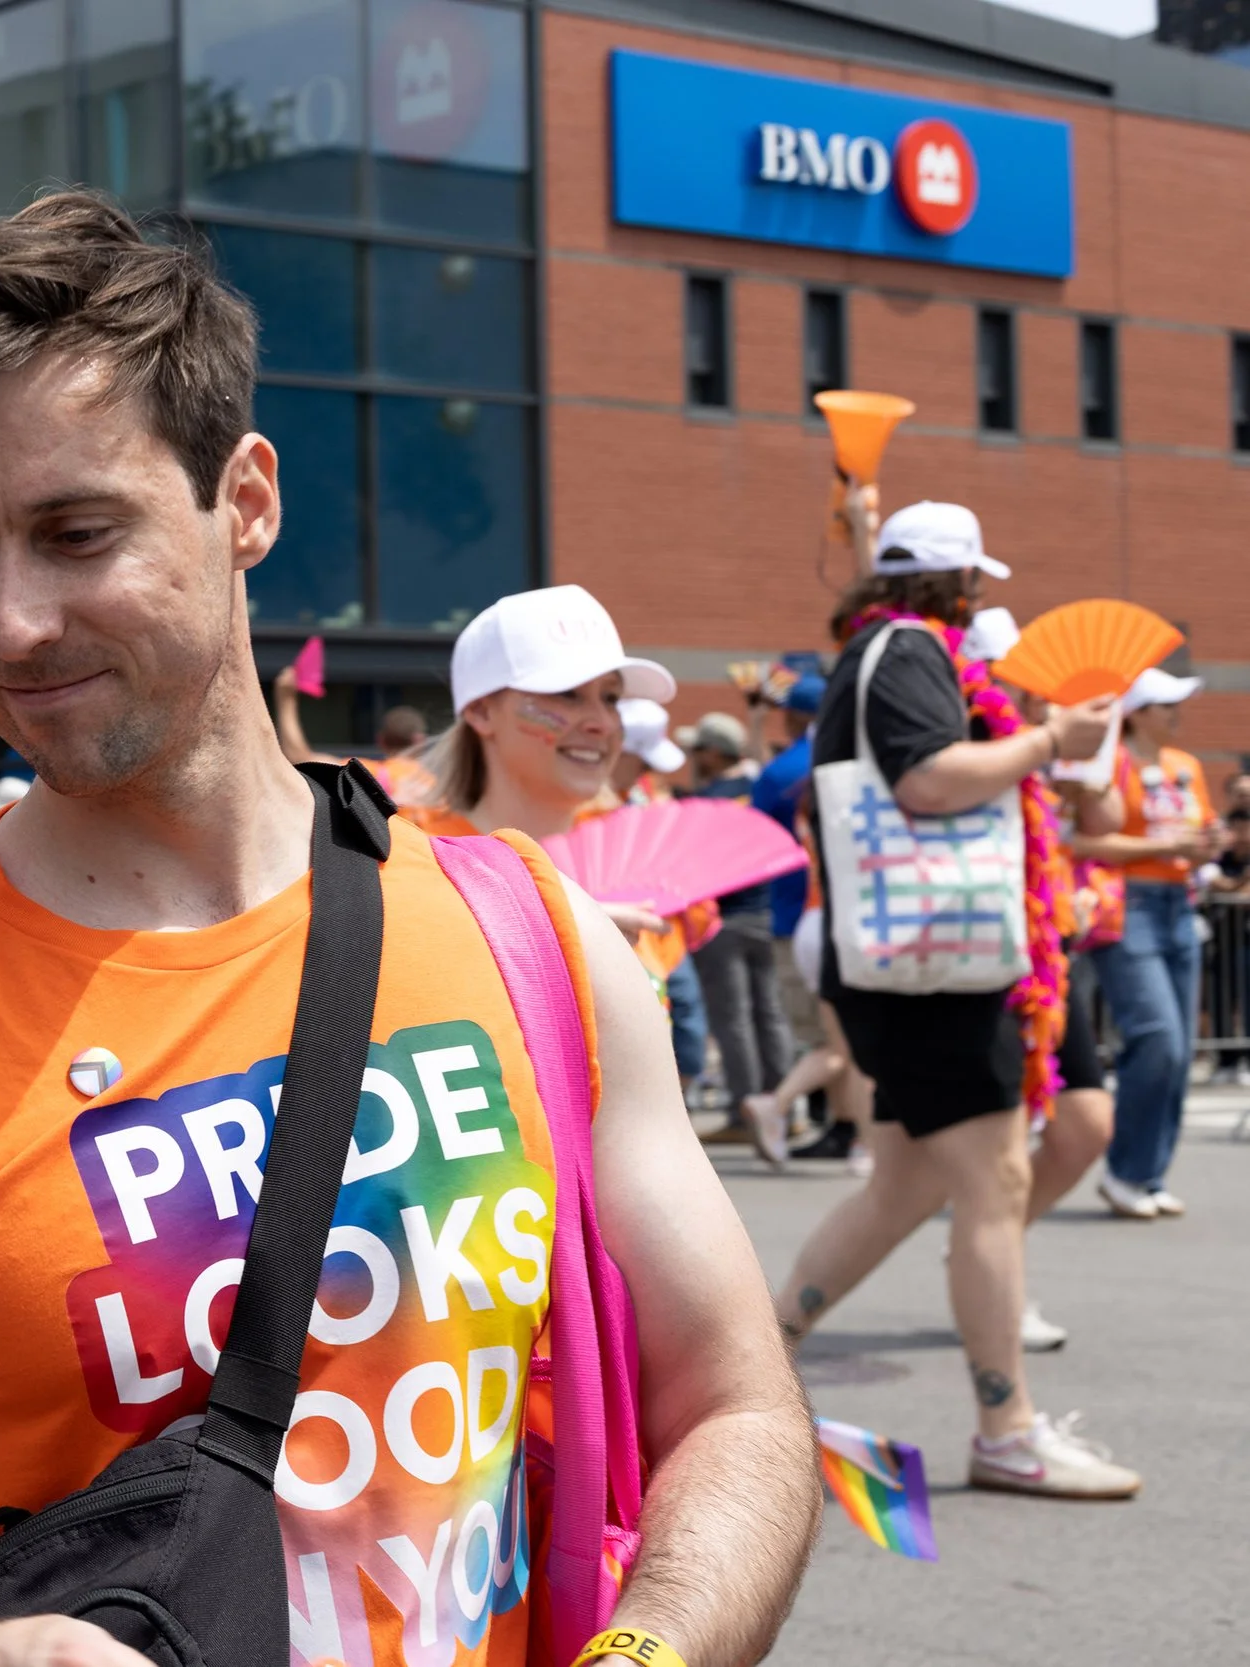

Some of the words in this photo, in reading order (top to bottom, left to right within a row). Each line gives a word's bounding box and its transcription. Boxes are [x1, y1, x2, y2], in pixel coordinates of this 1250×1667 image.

[759, 121, 892, 196] BMO
[93, 1044, 505, 1246] PRDE
[154, 1344, 519, 1511] OOD
[288, 1550, 346, 1667] N
[376, 1460, 523, 1648] YOU
